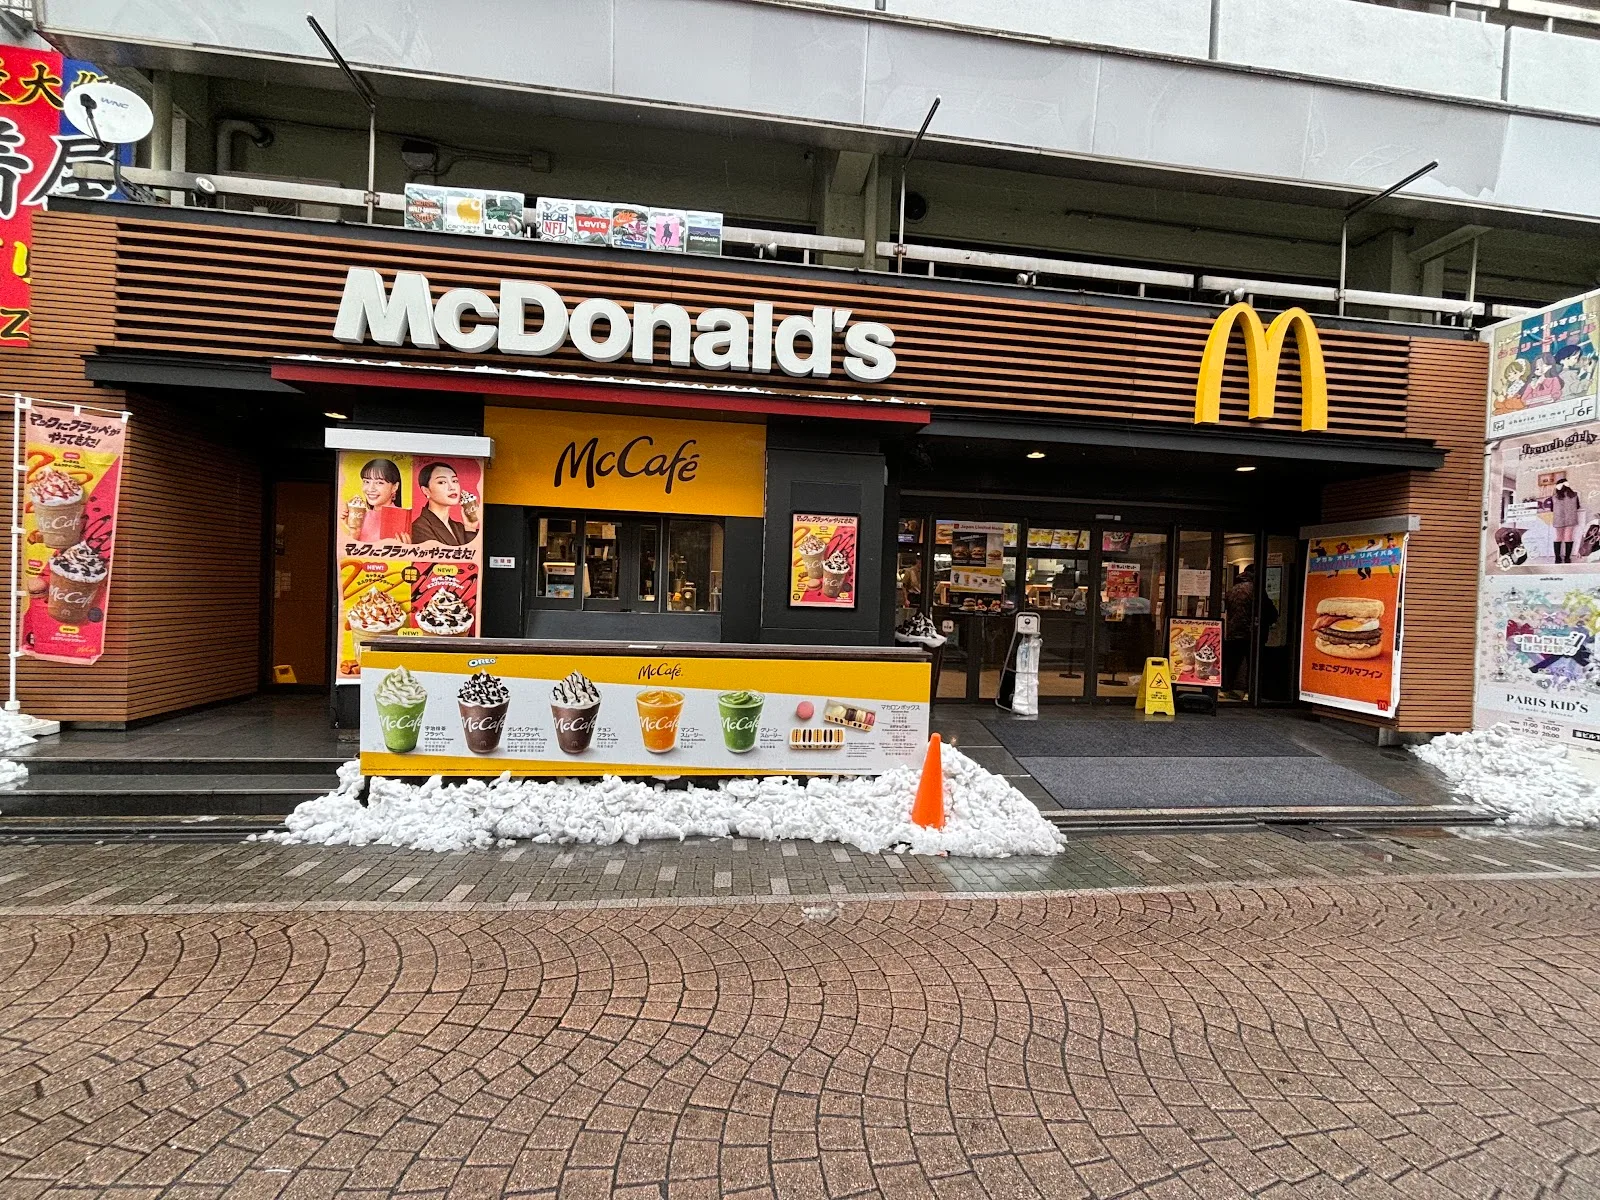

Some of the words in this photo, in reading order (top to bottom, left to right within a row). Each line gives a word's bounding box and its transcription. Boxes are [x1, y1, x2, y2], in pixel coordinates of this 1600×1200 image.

[101, 97, 129, 109] WNC
[544, 221, 565, 235] NFL
[332, 266, 897, 383] McDonald's
[1577, 405, 1593, 417] 6F
[29, 413, 122, 436] マックにフラッペが
[553, 435, 700, 494] McCafé
[344, 543, 477, 560] マックにフラッペがやってきた!
[467, 658, 496, 668] OREO
[1506, 693, 1546, 708] PARIS
[1550, 699, 1589, 713] KID'S
